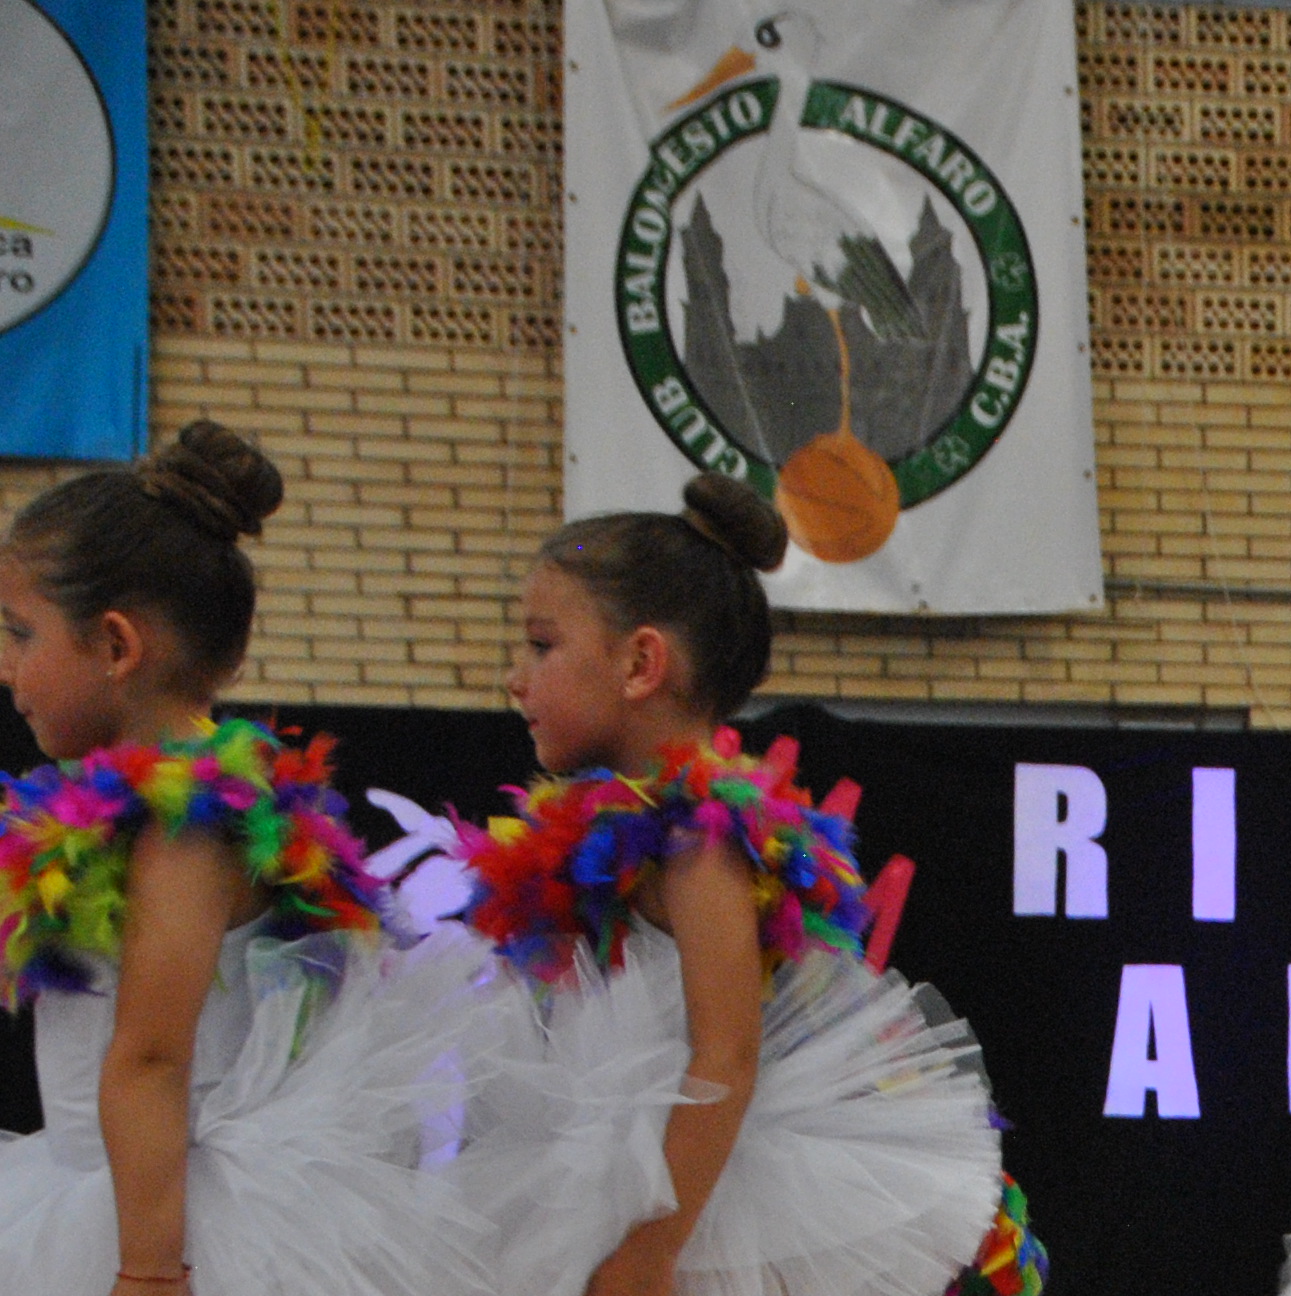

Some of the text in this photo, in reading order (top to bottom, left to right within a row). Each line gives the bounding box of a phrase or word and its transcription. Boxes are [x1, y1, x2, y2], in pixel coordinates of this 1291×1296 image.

[652, 376, 748, 481] CLUB
[840, 95, 997, 217] ALFARO
[970, 311, 1030, 428] C.B.A.
